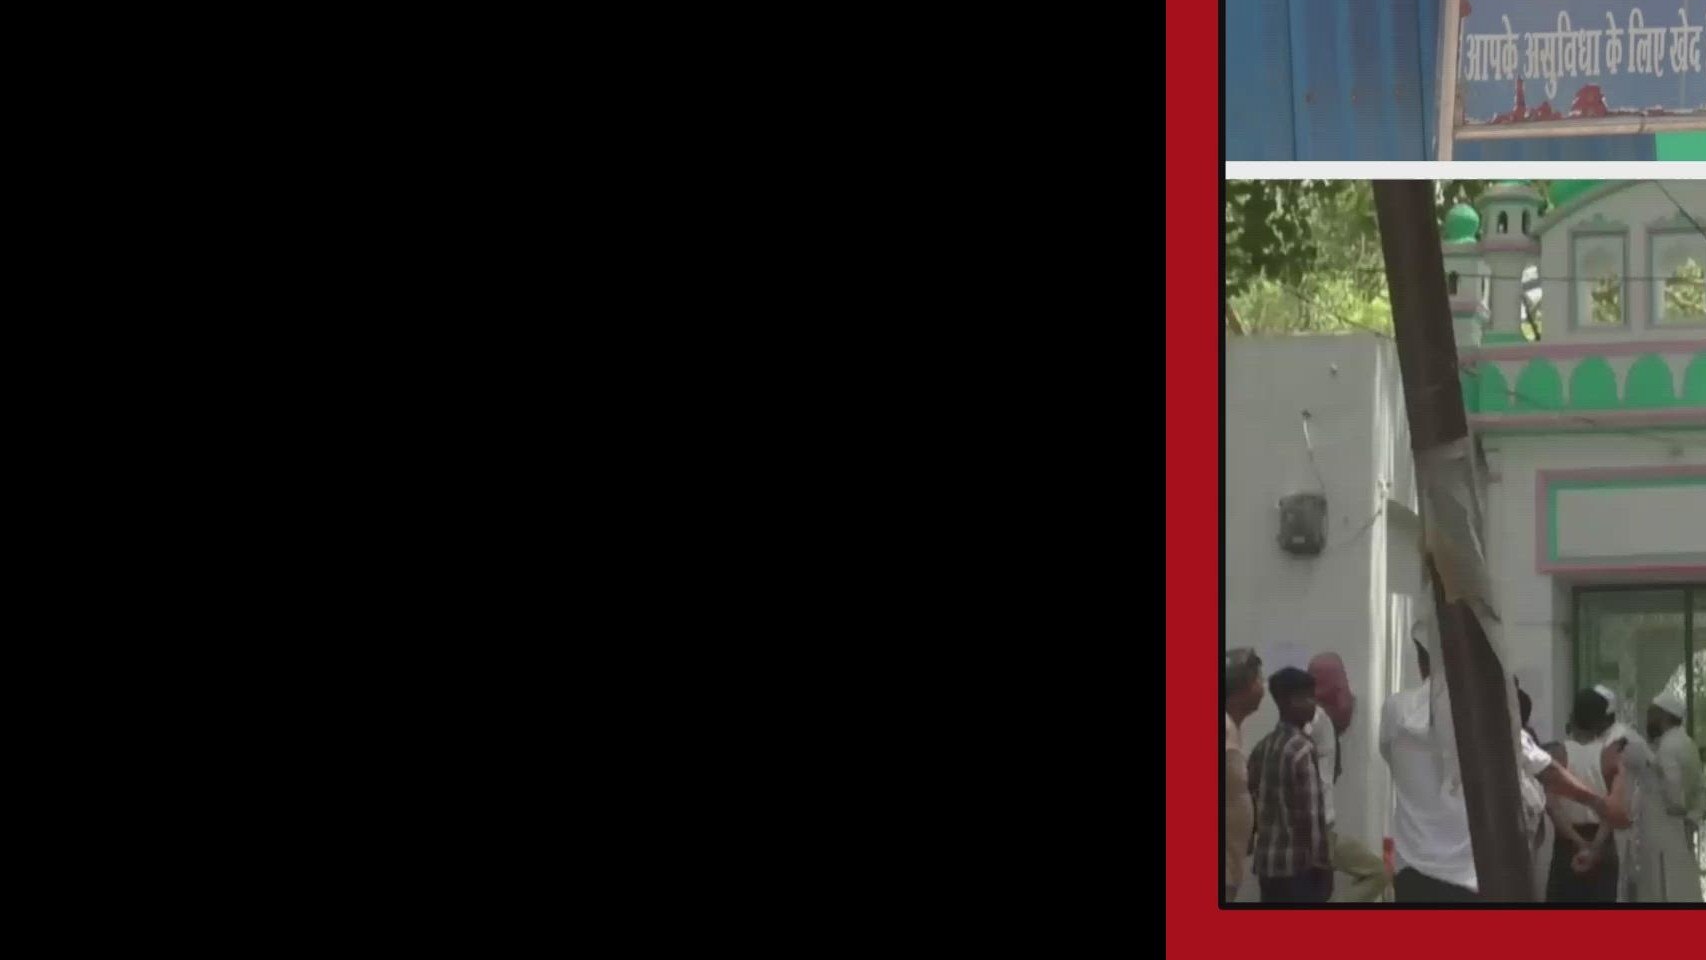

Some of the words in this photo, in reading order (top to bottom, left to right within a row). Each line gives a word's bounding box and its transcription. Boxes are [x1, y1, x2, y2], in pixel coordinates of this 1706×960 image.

[1464, 13, 1519, 81] आपके
[1523, 10, 1602, 99] असुविधा
[1605, 11, 1624, 74] के
[1627, 7, 1667, 77] लिए
[1669, 8, 1703, 73] खेद
